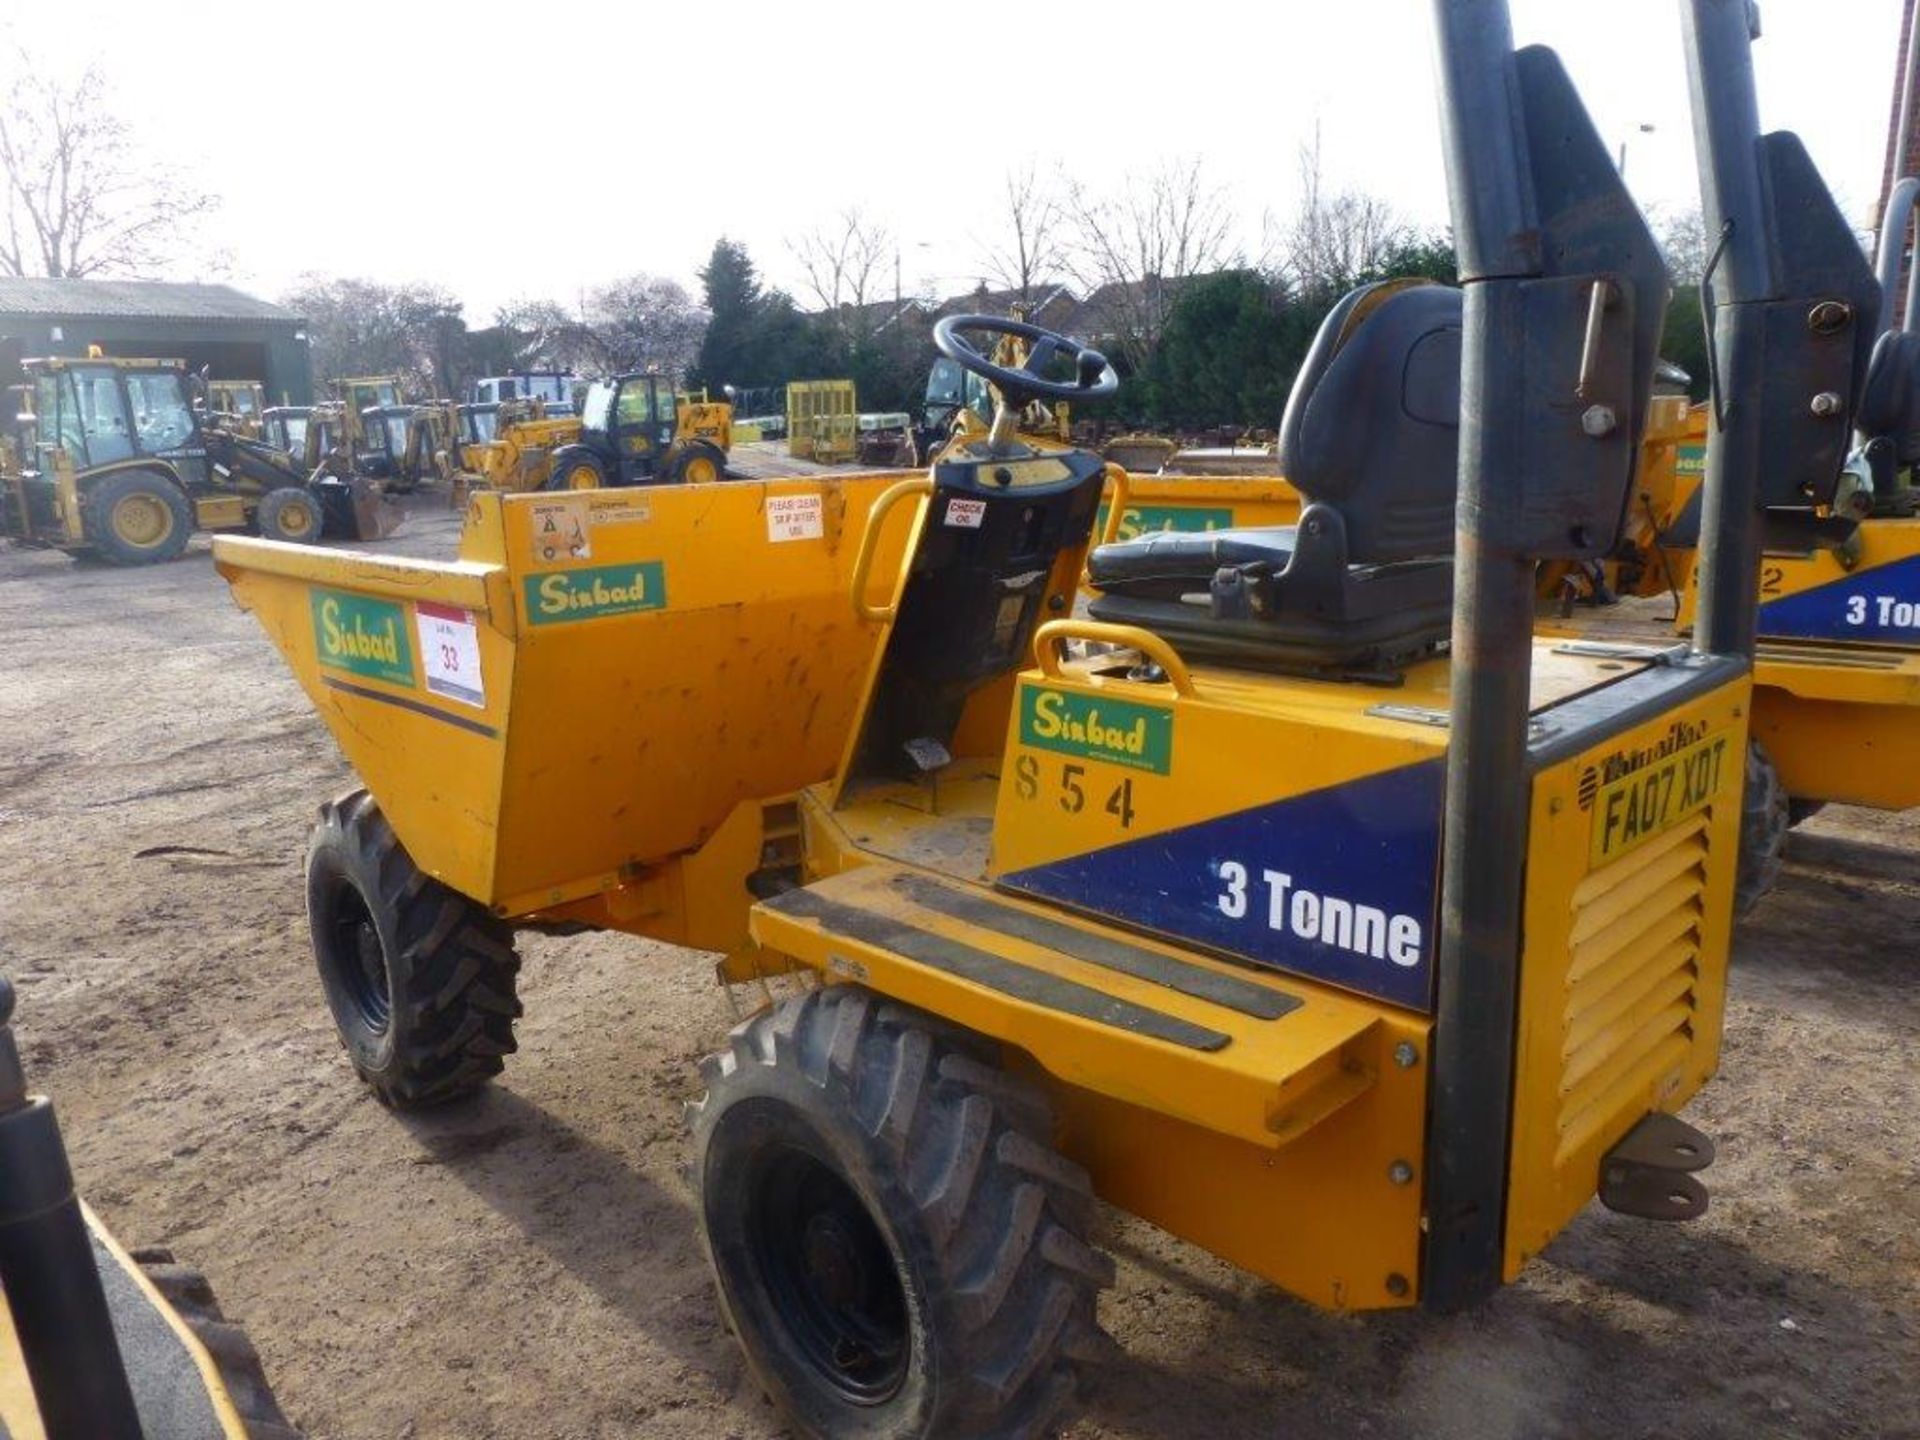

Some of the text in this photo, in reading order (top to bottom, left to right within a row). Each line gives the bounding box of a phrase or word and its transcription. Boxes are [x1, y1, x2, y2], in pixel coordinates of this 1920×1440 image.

[539, 572, 645, 614] Sinbad
[1846, 595, 1868, 626] 3
[321, 597, 399, 665] Sinbad
[441, 644, 460, 672] 33
[1033, 690, 1146, 755] Sinbad
[1602, 738, 1727, 855] FA07 XDT
[1218, 860, 1423, 969] 3 Tonne
